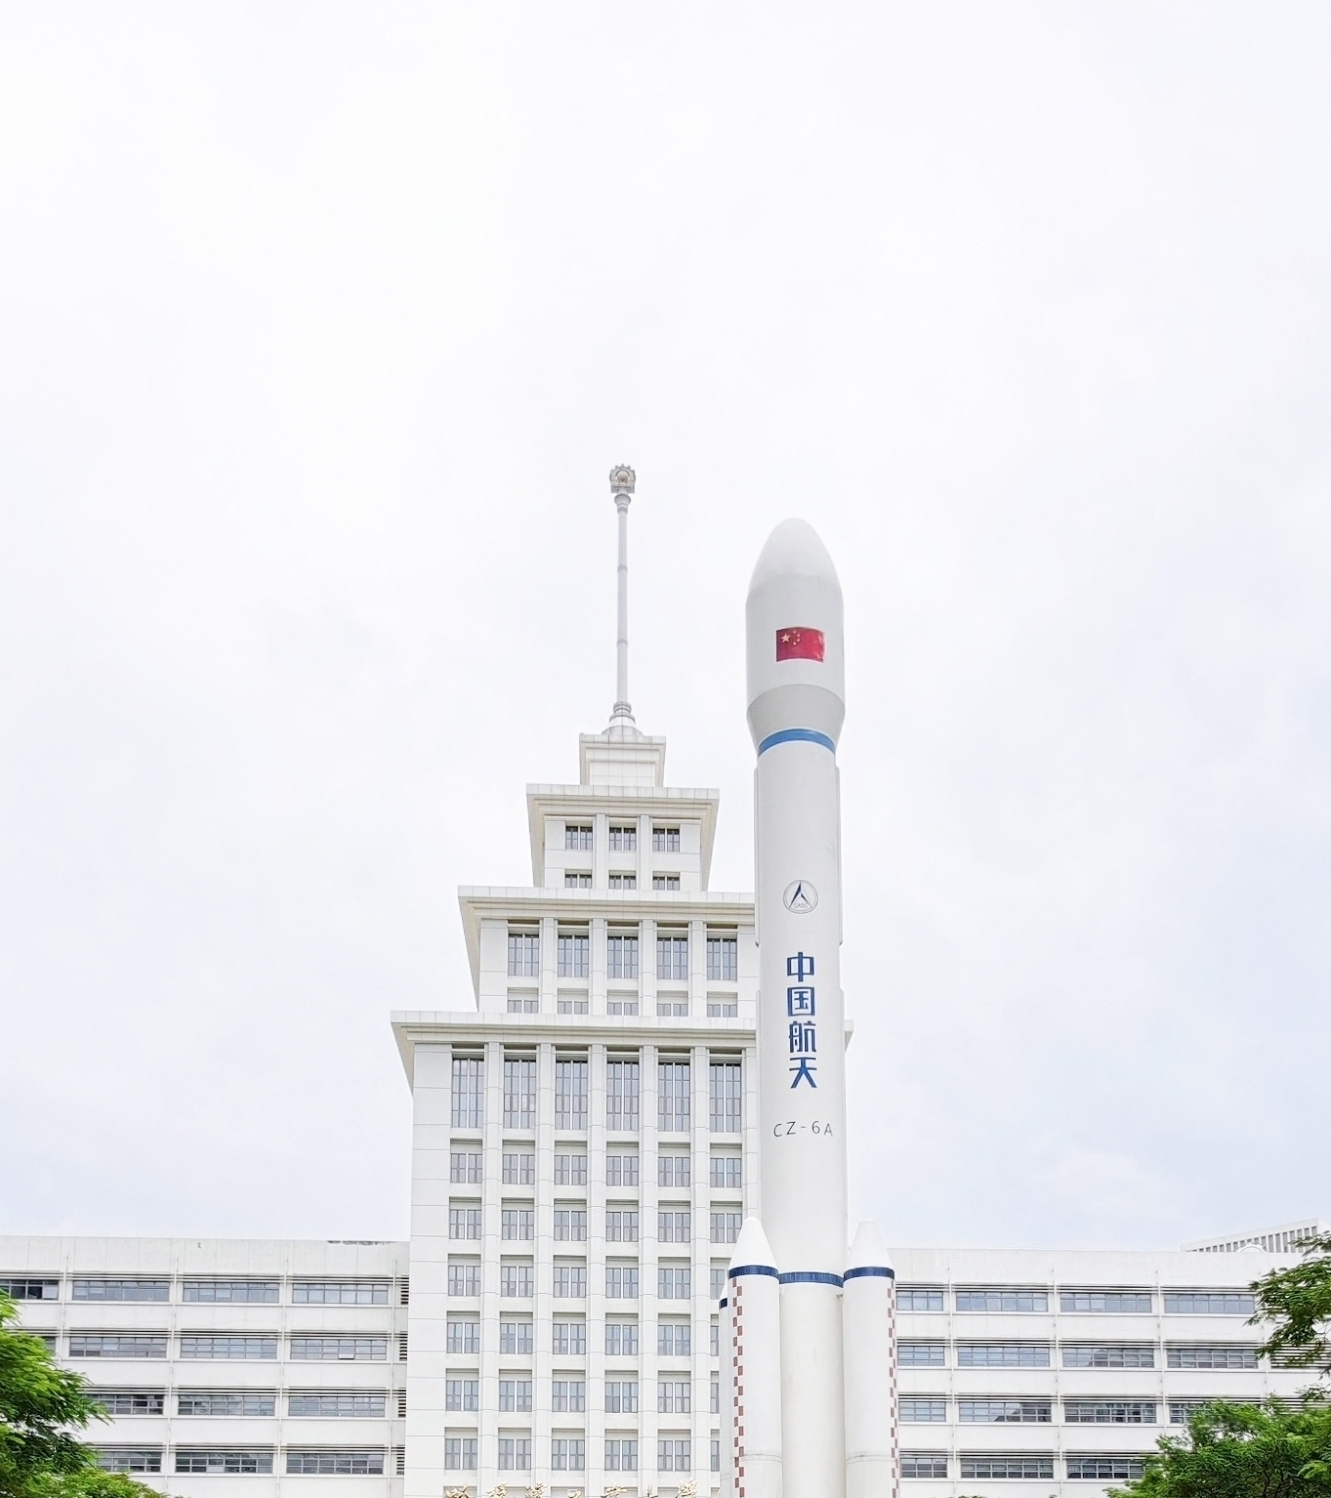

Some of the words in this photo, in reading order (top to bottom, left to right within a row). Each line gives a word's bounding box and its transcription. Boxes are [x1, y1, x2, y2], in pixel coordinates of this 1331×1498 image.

[786, 952, 817, 1089] 中国航天
[773, 1120, 833, 1138] CZ-6A
